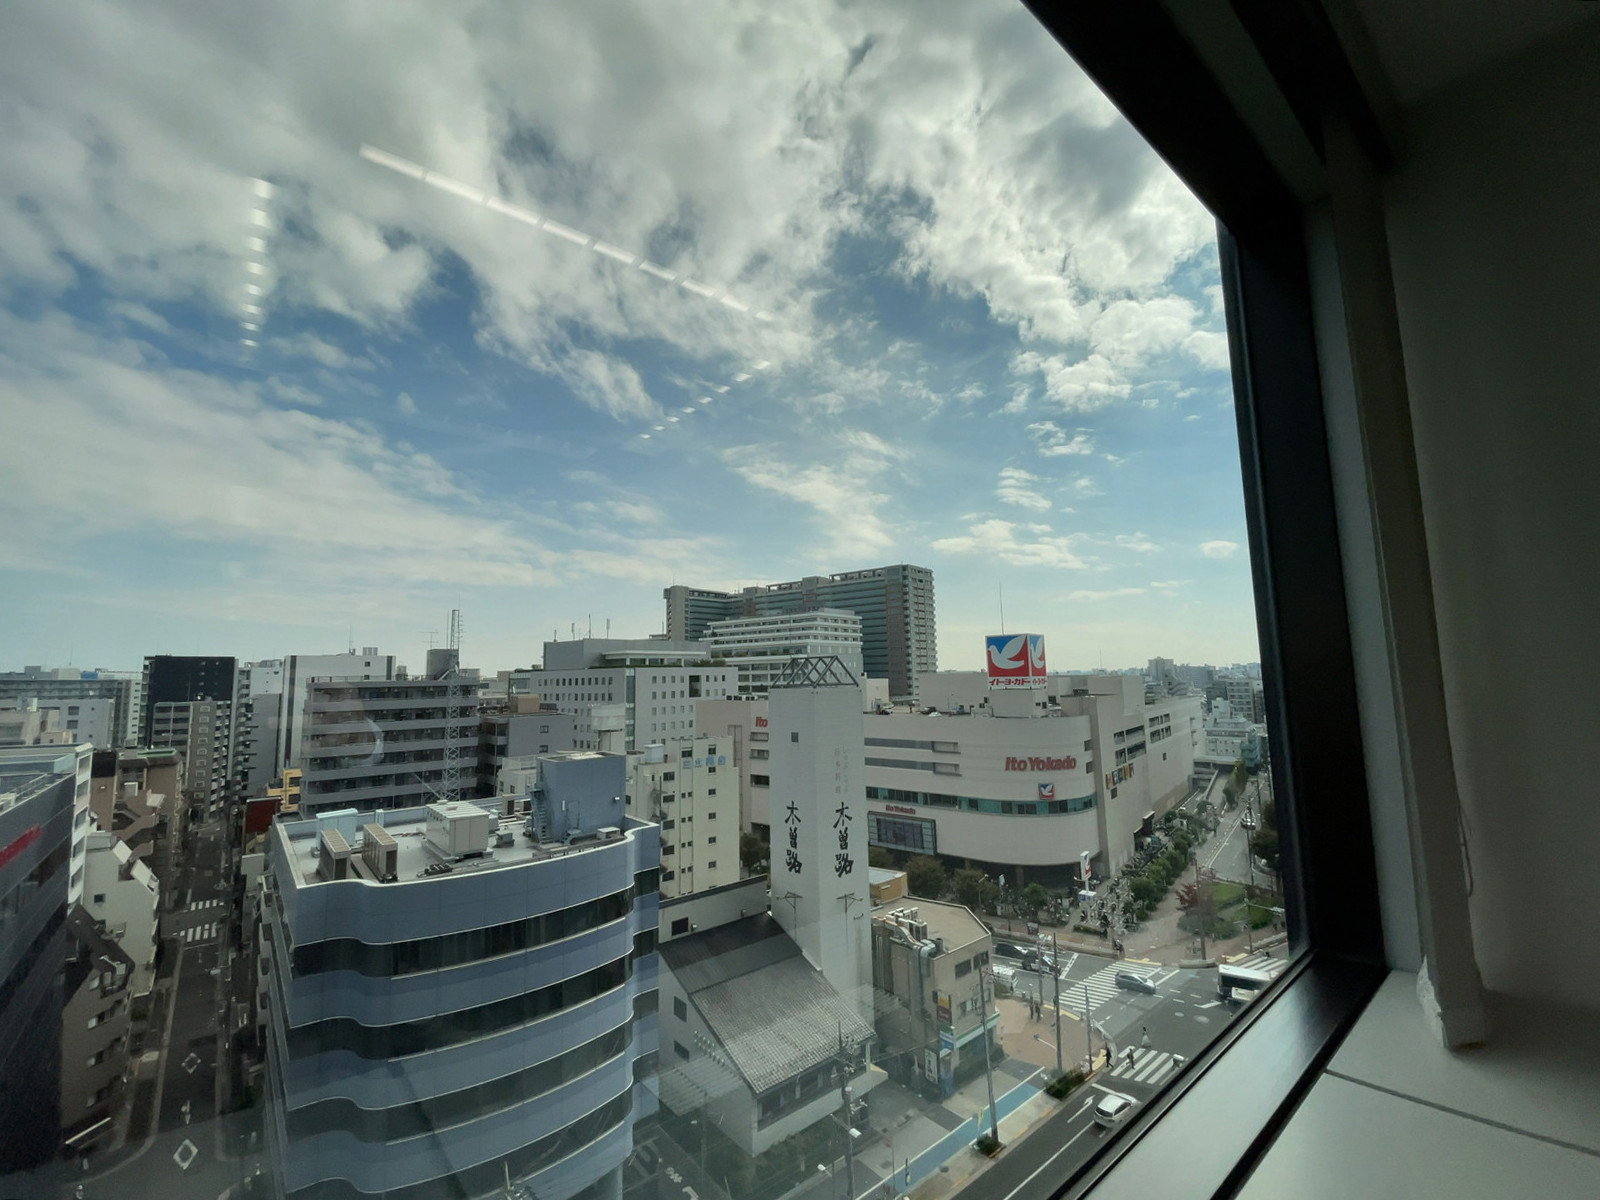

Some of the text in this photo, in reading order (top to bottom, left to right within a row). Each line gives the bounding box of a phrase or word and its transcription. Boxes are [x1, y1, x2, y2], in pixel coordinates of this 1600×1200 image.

[755, 716, 768, 728] Ito
[1005, 755, 1077, 771] Ito Yokado
